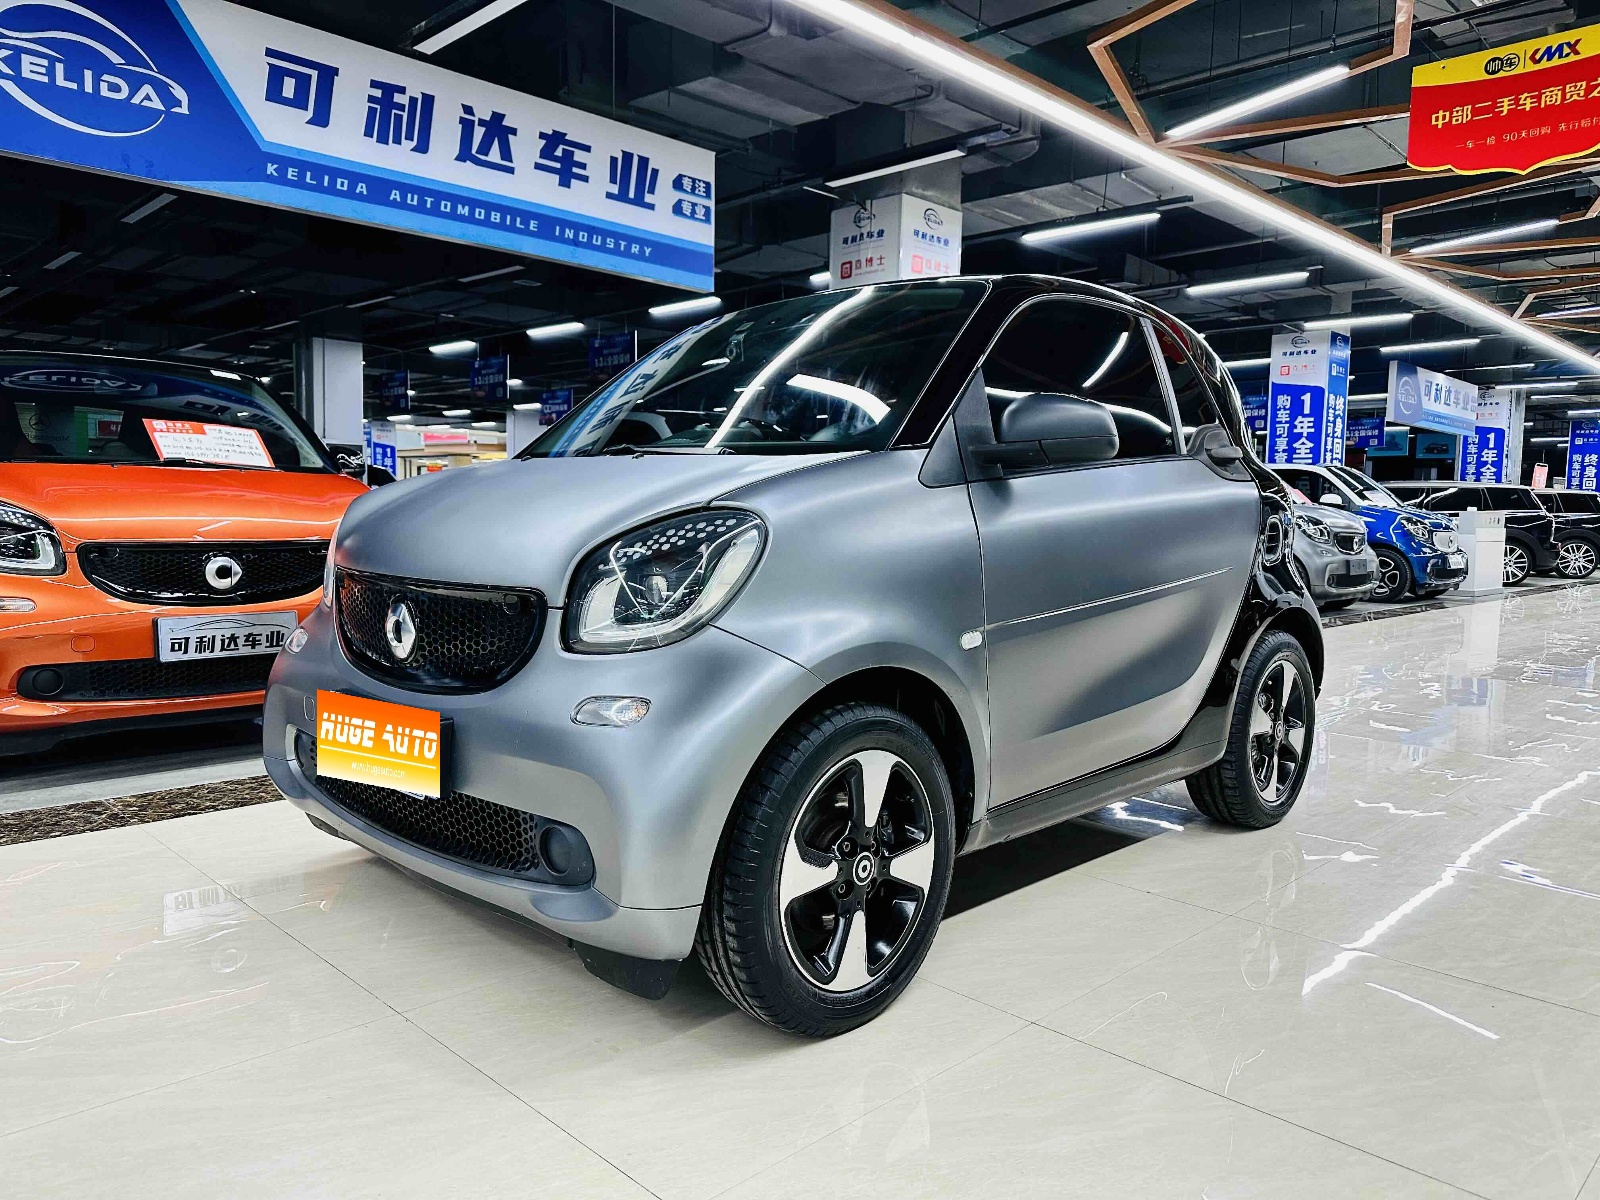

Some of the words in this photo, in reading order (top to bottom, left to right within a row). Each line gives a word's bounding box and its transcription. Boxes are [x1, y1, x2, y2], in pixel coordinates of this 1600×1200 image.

[265, 47, 659, 211] 可利达车业
[1455, 136, 1496, 149] 一车一检
[1503, 126, 1551, 142] 90天回购
[682, 176, 706, 196] 专注
[266, 162, 367, 195] KELIDA
[390, 189, 539, 231] AUTOMOBILE
[555, 225, 653, 257] INDUSTRY
[681, 200, 706, 220] 专业
[913, 228, 950, 247] 可利达车业
[1424, 380, 1469, 411] 可利达车业
[169, 630, 285, 655] 可利达车业
